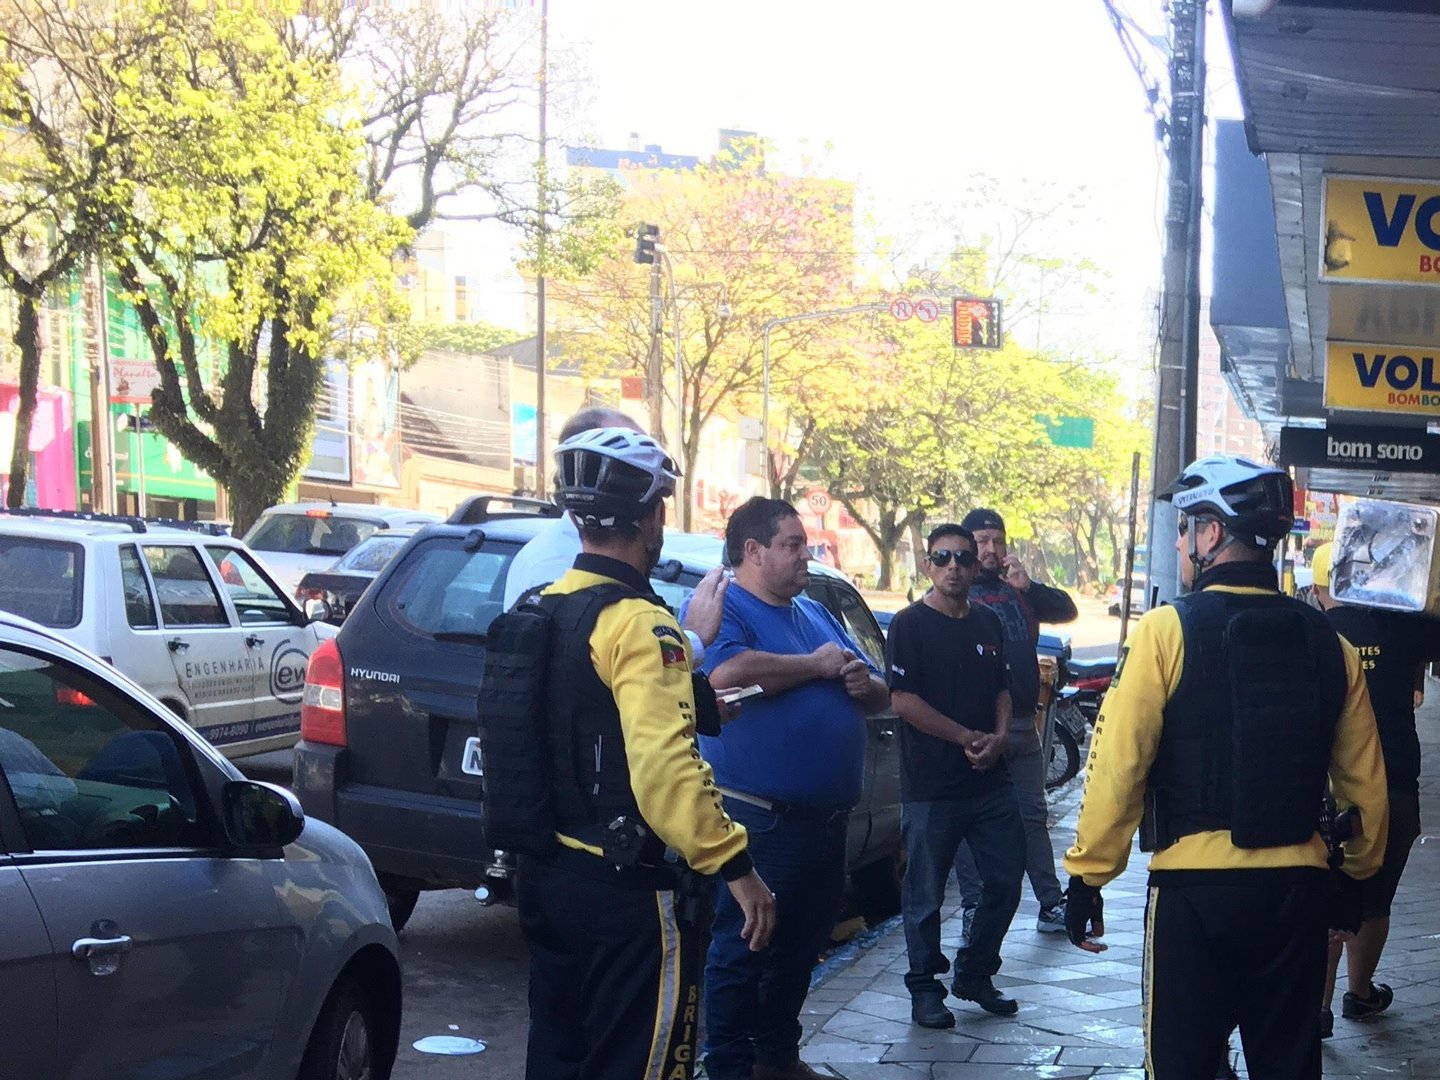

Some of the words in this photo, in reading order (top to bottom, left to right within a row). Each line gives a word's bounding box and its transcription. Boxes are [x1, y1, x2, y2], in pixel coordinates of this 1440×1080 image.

[1327, 436, 1372, 458] bom
[1377, 443, 1423, 461] sono
[811, 495, 827, 507] 50
[185, 656, 265, 679] ENGENHARIA
[350, 667, 401, 684] HYUNDAI
